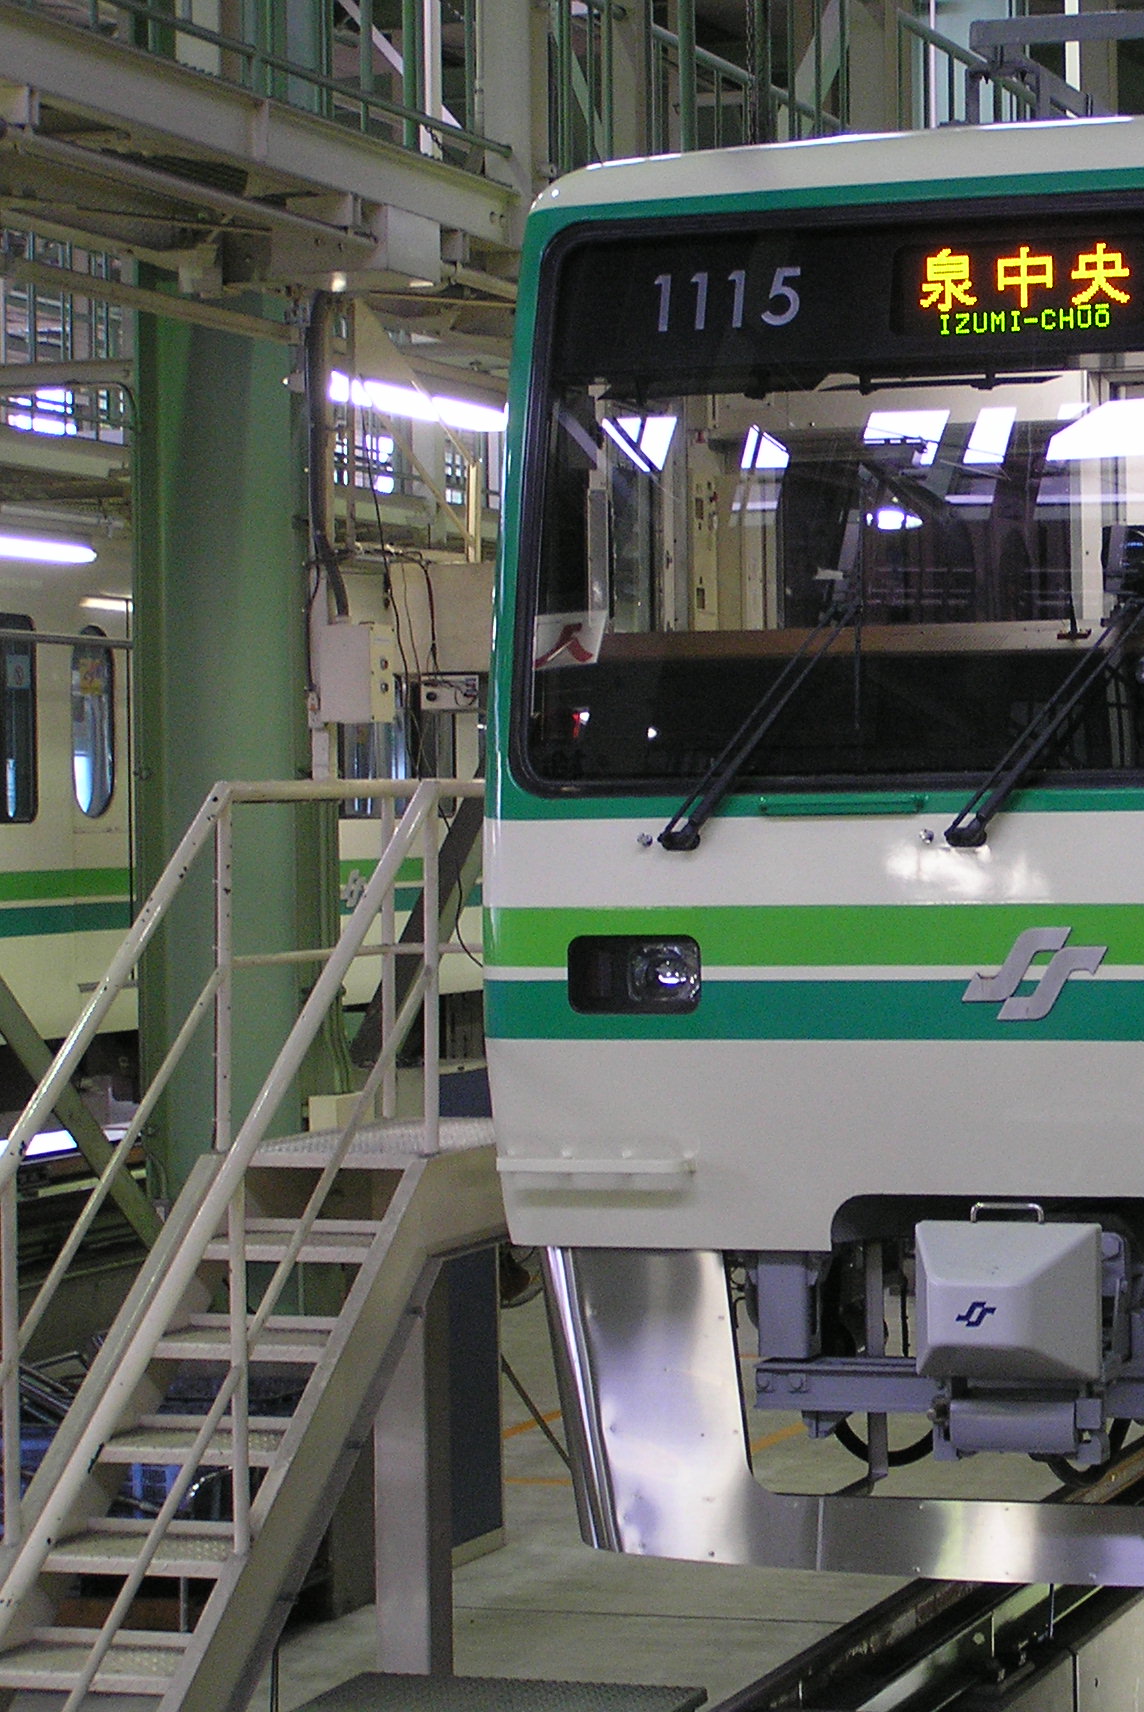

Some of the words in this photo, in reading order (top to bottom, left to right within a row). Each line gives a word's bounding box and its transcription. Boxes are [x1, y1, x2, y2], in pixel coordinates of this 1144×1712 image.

[654, 266, 801, 333] 1115
[919, 242, 1131, 312] 泉中央
